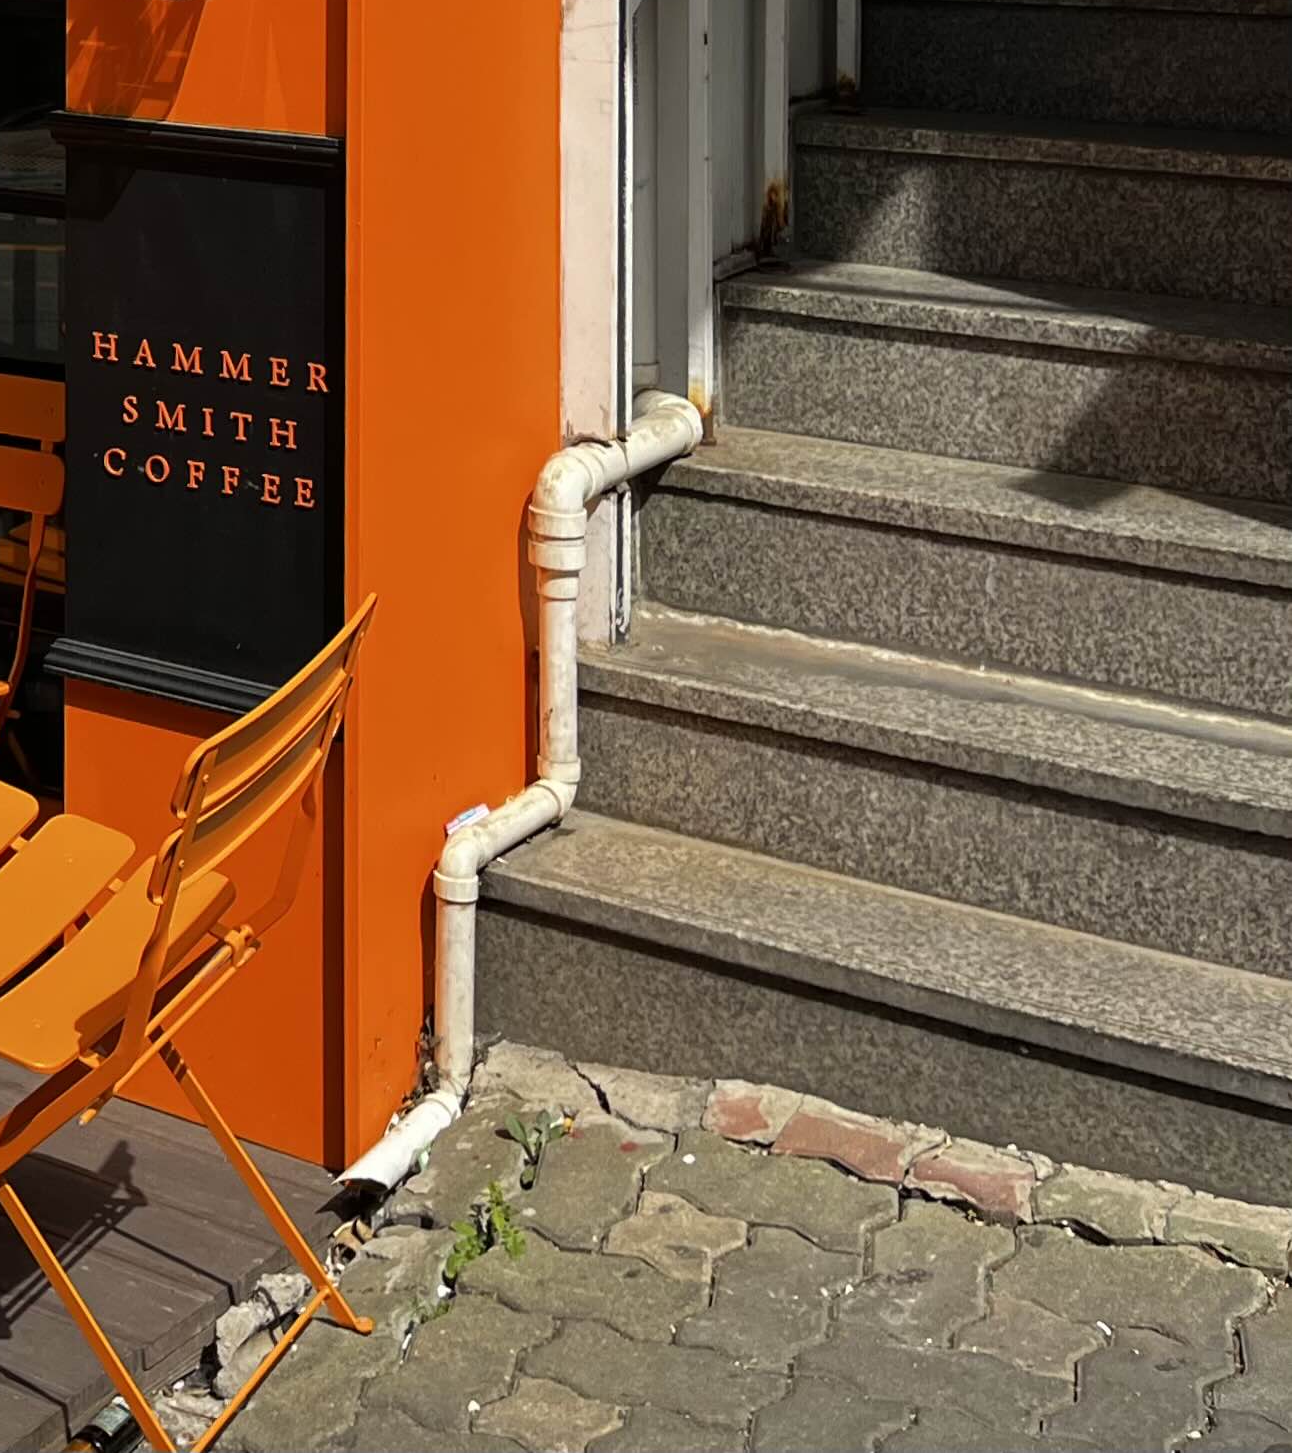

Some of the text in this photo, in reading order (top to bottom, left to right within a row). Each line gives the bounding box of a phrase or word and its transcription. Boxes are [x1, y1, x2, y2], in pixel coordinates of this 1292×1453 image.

[92, 331, 329, 393] HAMMER
[122, 395, 297, 450] SMITH
[103, 448, 315, 508] COFFEE
